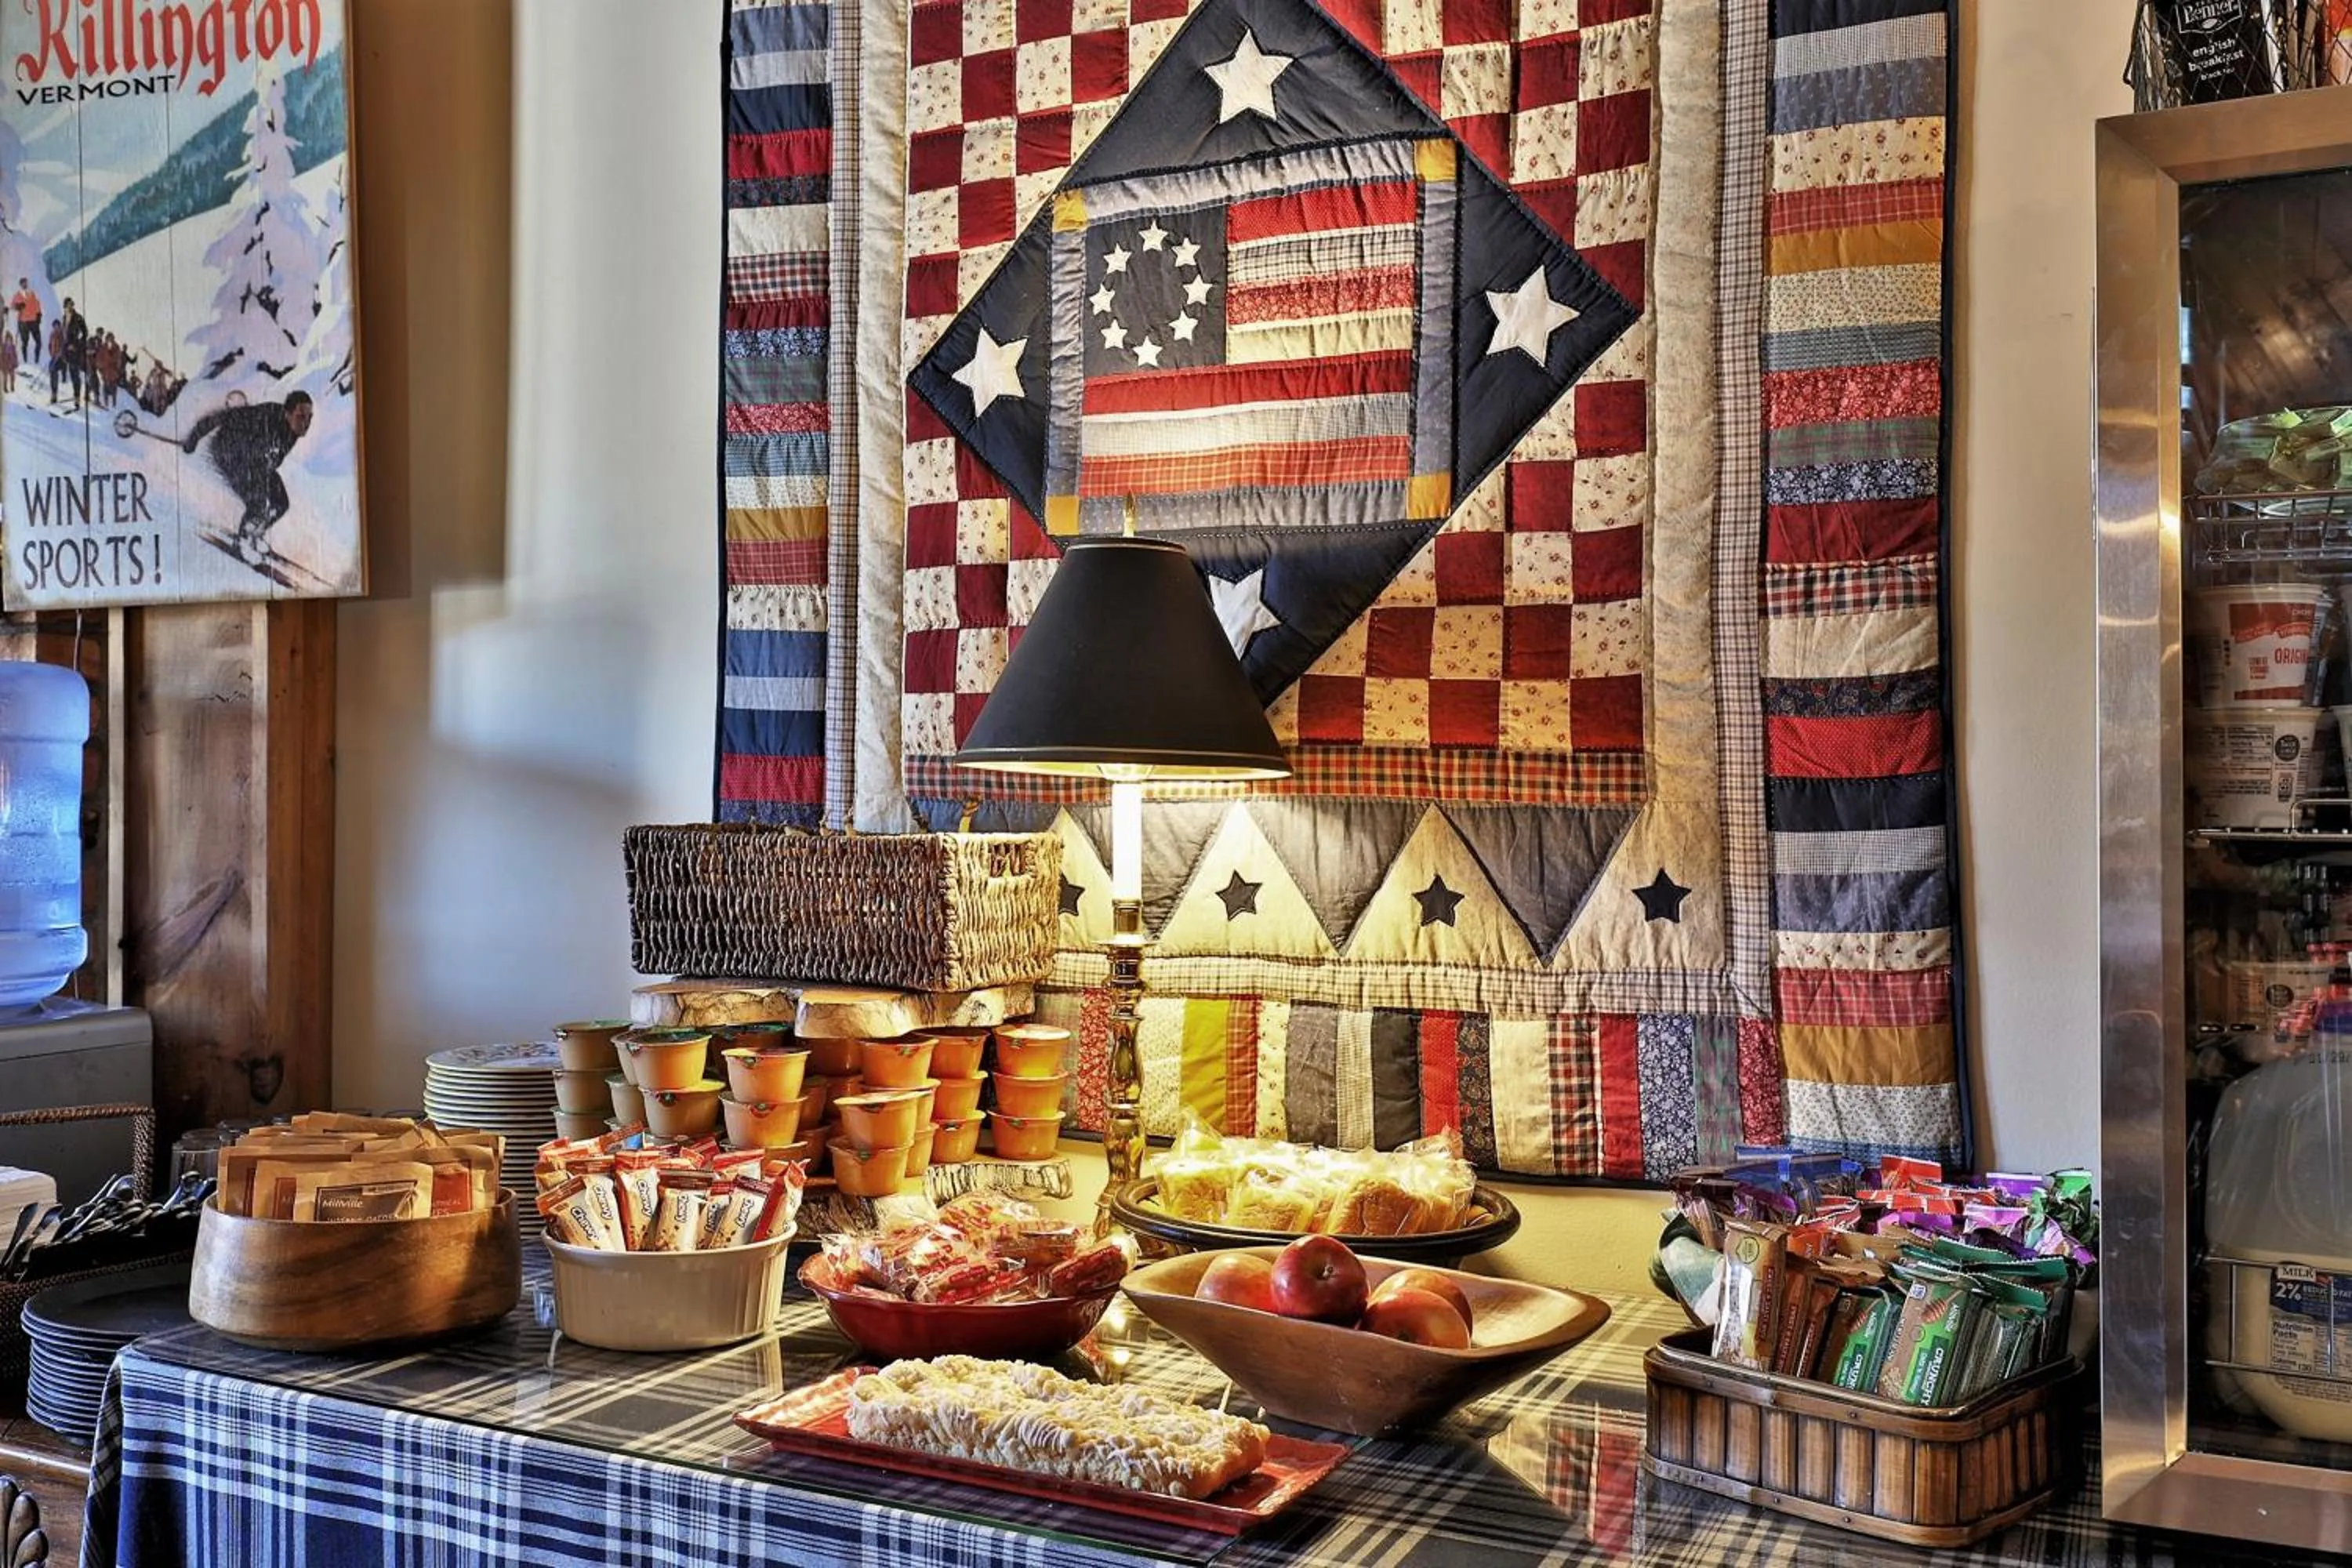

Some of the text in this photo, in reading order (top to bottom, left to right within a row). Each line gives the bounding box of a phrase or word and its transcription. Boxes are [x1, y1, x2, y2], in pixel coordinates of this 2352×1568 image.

[16, 0, 321, 96] Killington
[16, 75, 176, 105] VERMONT
[22, 472, 153, 527] WINTER
[23, 534, 162, 590] SPORTS!
[322, 1196, 363, 1208] Millville
[593, 1185, 612, 1220] Chewy
[637, 1179, 652, 1217] Chewy
[674, 1194, 688, 1223] Chewy
[735, 1198, 754, 1228] Chewy
[571, 1206, 600, 1240] Chewy
[2282, 1265, 2315, 1279] MILK
[2275, 1282, 2303, 1301] 2%
[2303, 1285, 2338, 1296] REDUCD
[1846, 1354, 1864, 1390] CRUN
[1921, 1348, 1944, 1406] CRUNCHY
